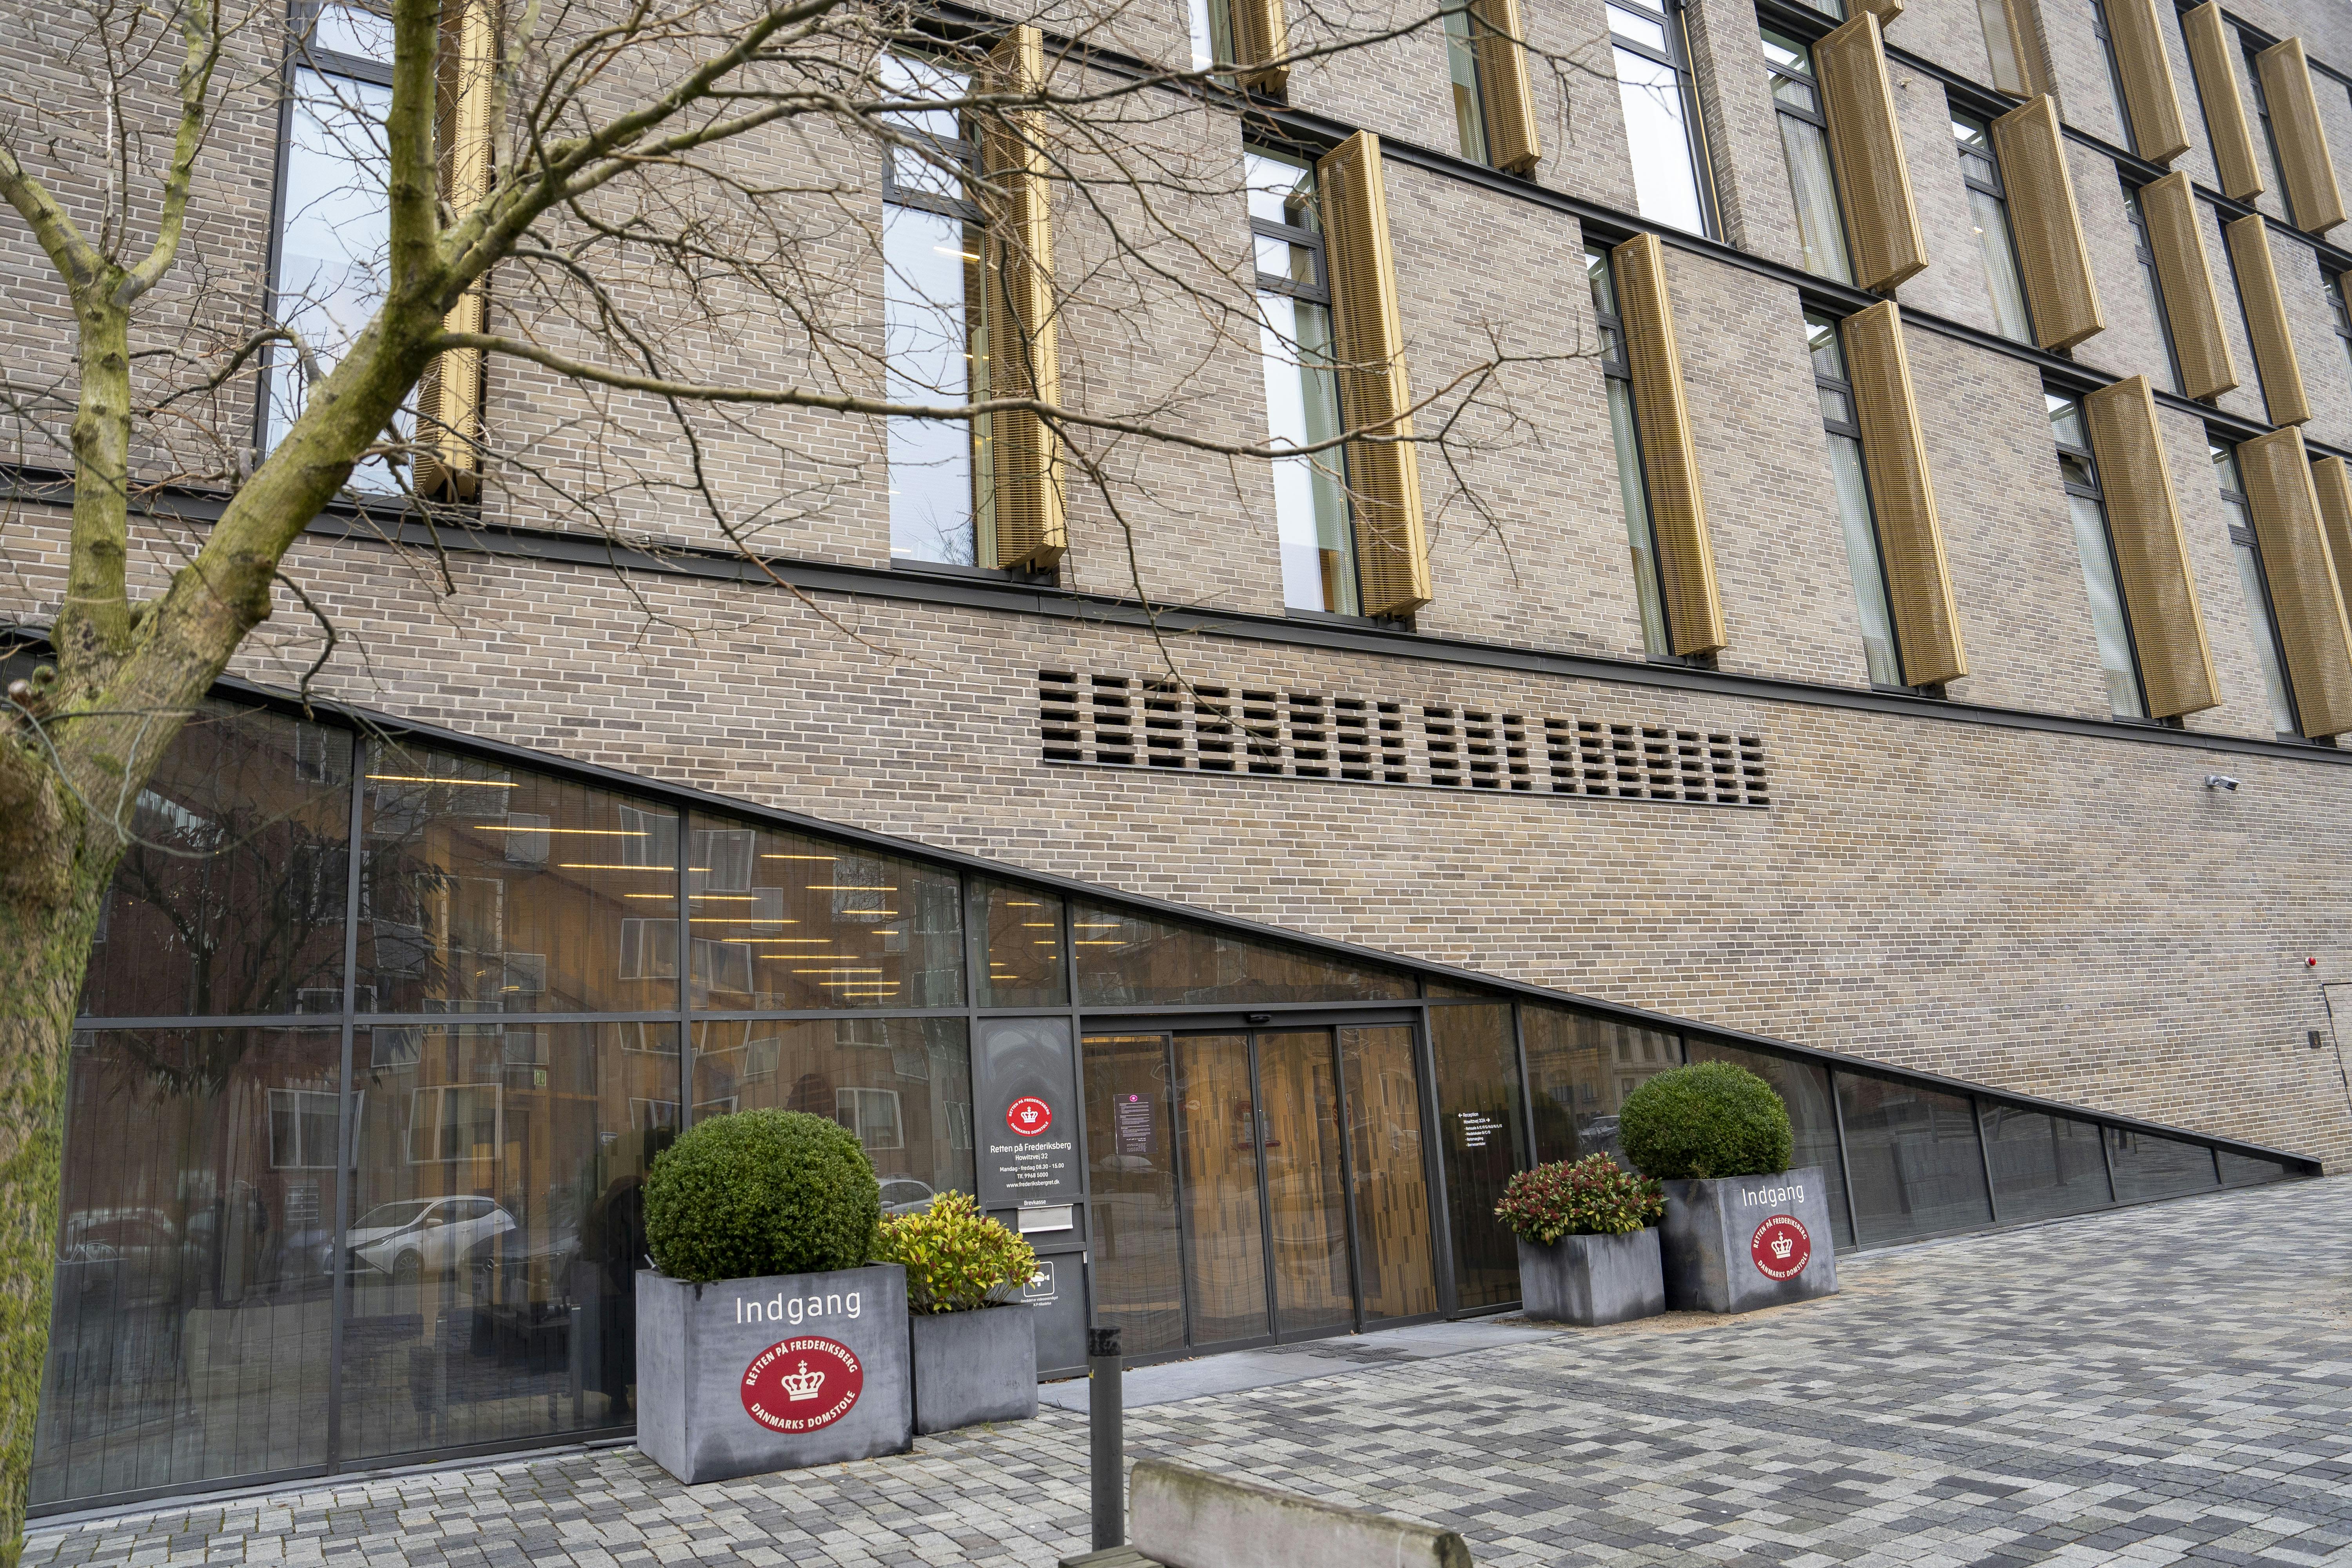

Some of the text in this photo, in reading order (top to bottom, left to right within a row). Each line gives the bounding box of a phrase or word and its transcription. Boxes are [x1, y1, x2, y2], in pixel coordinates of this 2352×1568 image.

[1009, 1103, 1019, 1116] RETTEN
[1024, 1098, 1050, 1115] FREDERIKSBERG
[1333, 1108, 1350, 1123] SP
[1011, 1121, 1049, 1134] DANMARKS DOMSTOLE
[1014, 1143, 1023, 1153] på
[1025, 1142, 1071, 1151] Frederiksberg
[1006, 1179, 1060, 1188] www.frederiksbergret.dk
[1742, 1185, 1804, 1207] Indgang
[1753, 1217, 1808, 1249] RETTEN PÅ FREDERIKSBERG
[1758, 1252, 1808, 1278] DANMARKS DOMSTOLE
[737, 1292, 861, 1325] Indgang
[746, 1340, 858, 1386] RETTEN PÅ FREDERIKSBERG
[751, 1390, 855, 1429] DANMARKS DOMSTOLE
